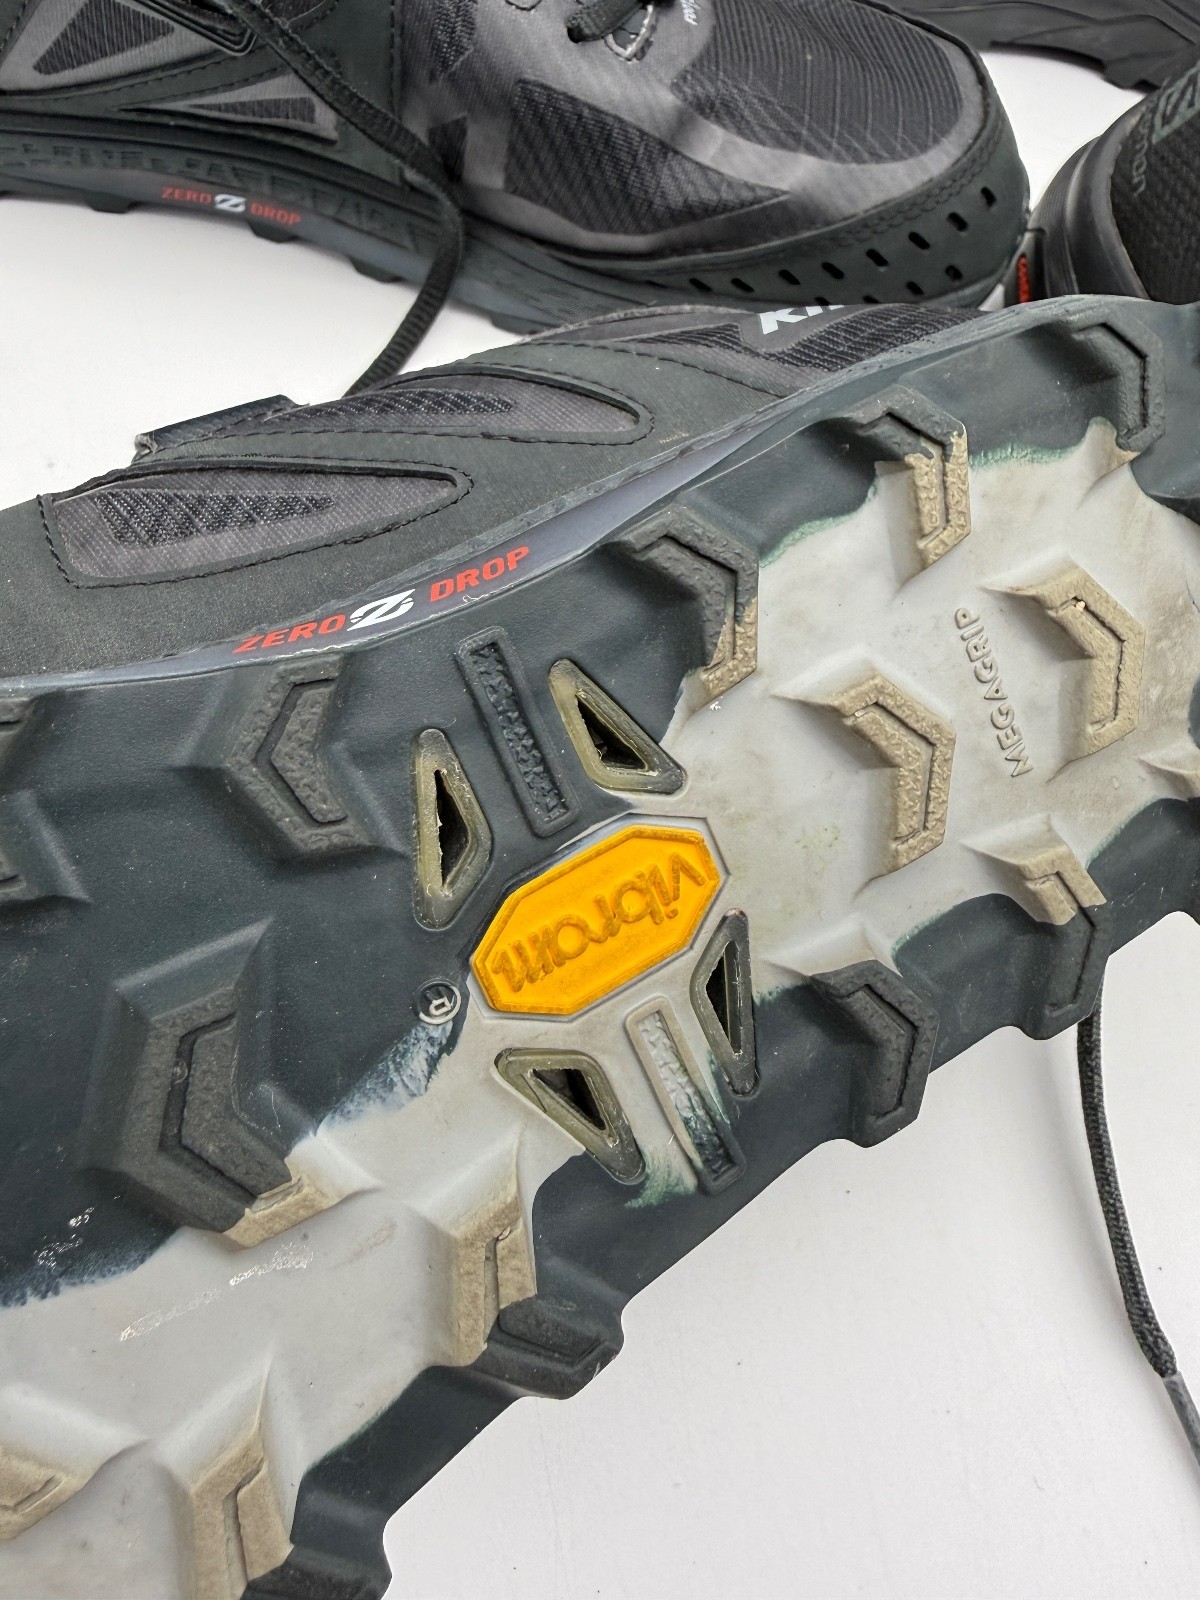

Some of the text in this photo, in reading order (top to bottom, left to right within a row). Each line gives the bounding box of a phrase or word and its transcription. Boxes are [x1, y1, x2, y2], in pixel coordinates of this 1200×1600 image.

[161, 186, 212, 204] ZERO
[251, 202, 302, 225] DROP
[233, 613, 346, 654] ZERO
[430, 546, 529, 603] DROP
[954, 607, 1034, 777] MEGAGRIP
[491, 852, 706, 992] vibram
